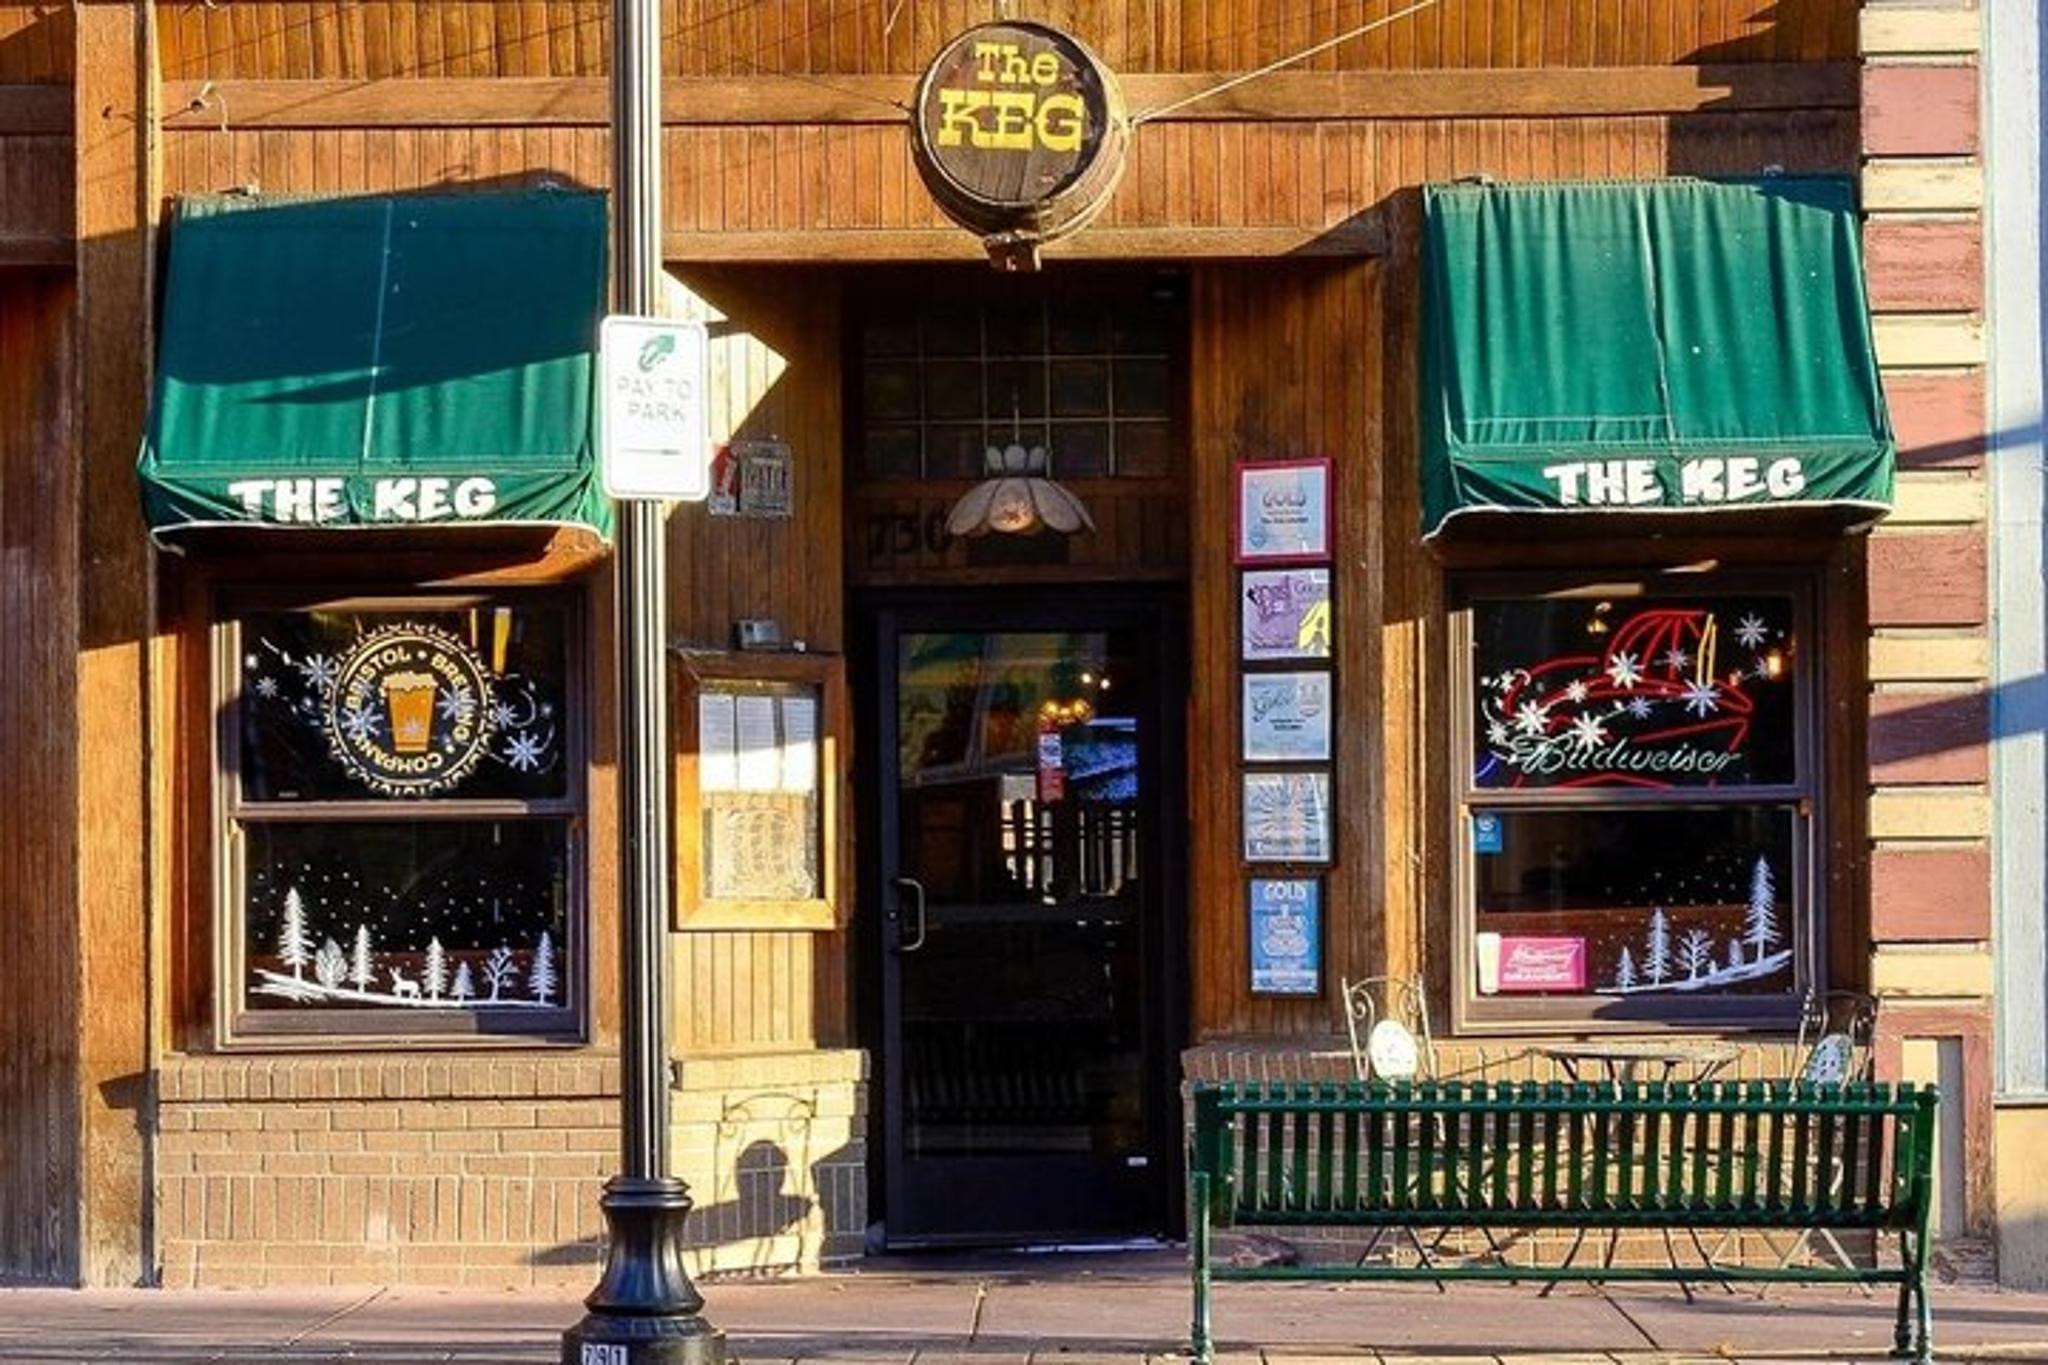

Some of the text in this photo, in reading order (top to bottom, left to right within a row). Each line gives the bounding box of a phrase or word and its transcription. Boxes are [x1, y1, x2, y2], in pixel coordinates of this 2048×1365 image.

[975, 42, 1059, 85] The
[938, 88, 1085, 151] KEG
[616, 376, 692, 400] PAY TO
[628, 401, 685, 422] PARK
[228, 477, 497, 521] THE KEG
[1543, 457, 1805, 505] THE KEG
[1510, 733, 1740, 774] Budweiser
